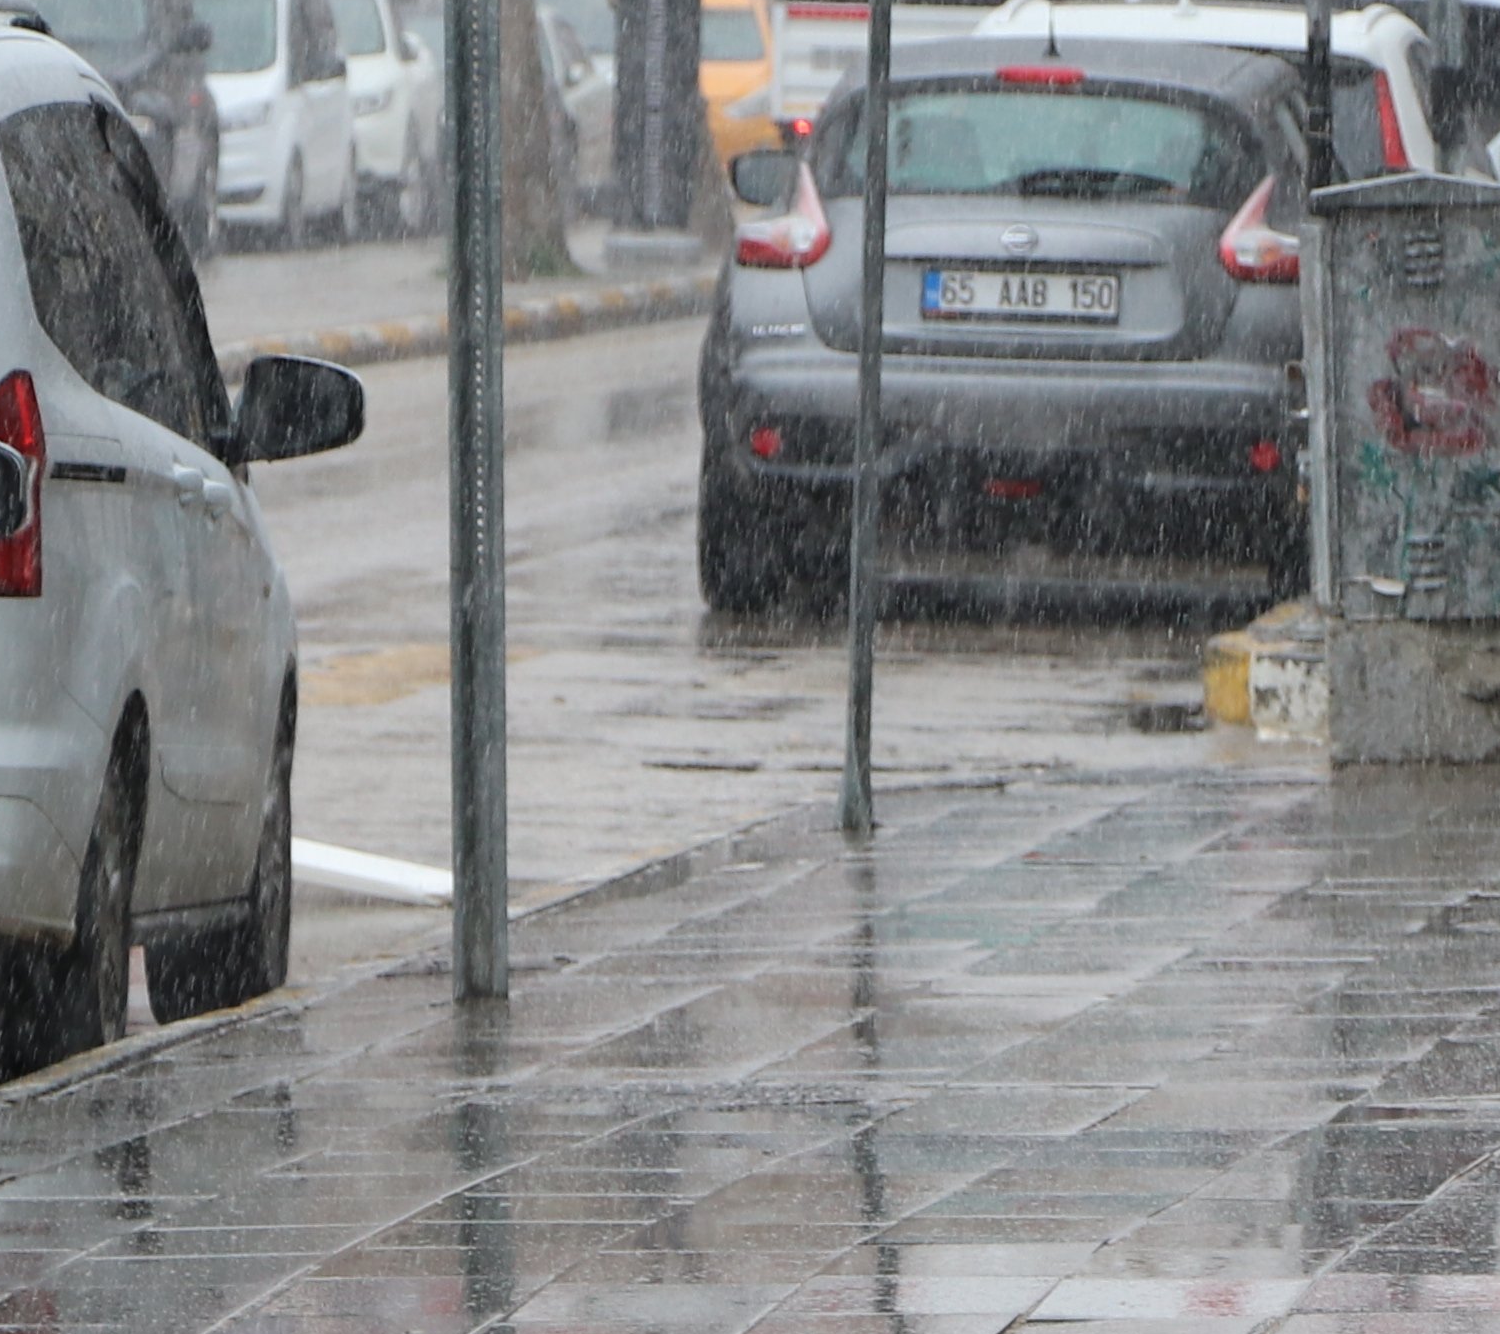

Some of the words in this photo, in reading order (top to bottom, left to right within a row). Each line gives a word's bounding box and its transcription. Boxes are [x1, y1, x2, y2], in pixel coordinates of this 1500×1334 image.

[942, 275, 975, 305] 65
[999, 278, 1048, 308] AAB
[1069, 279, 1113, 310] 150
